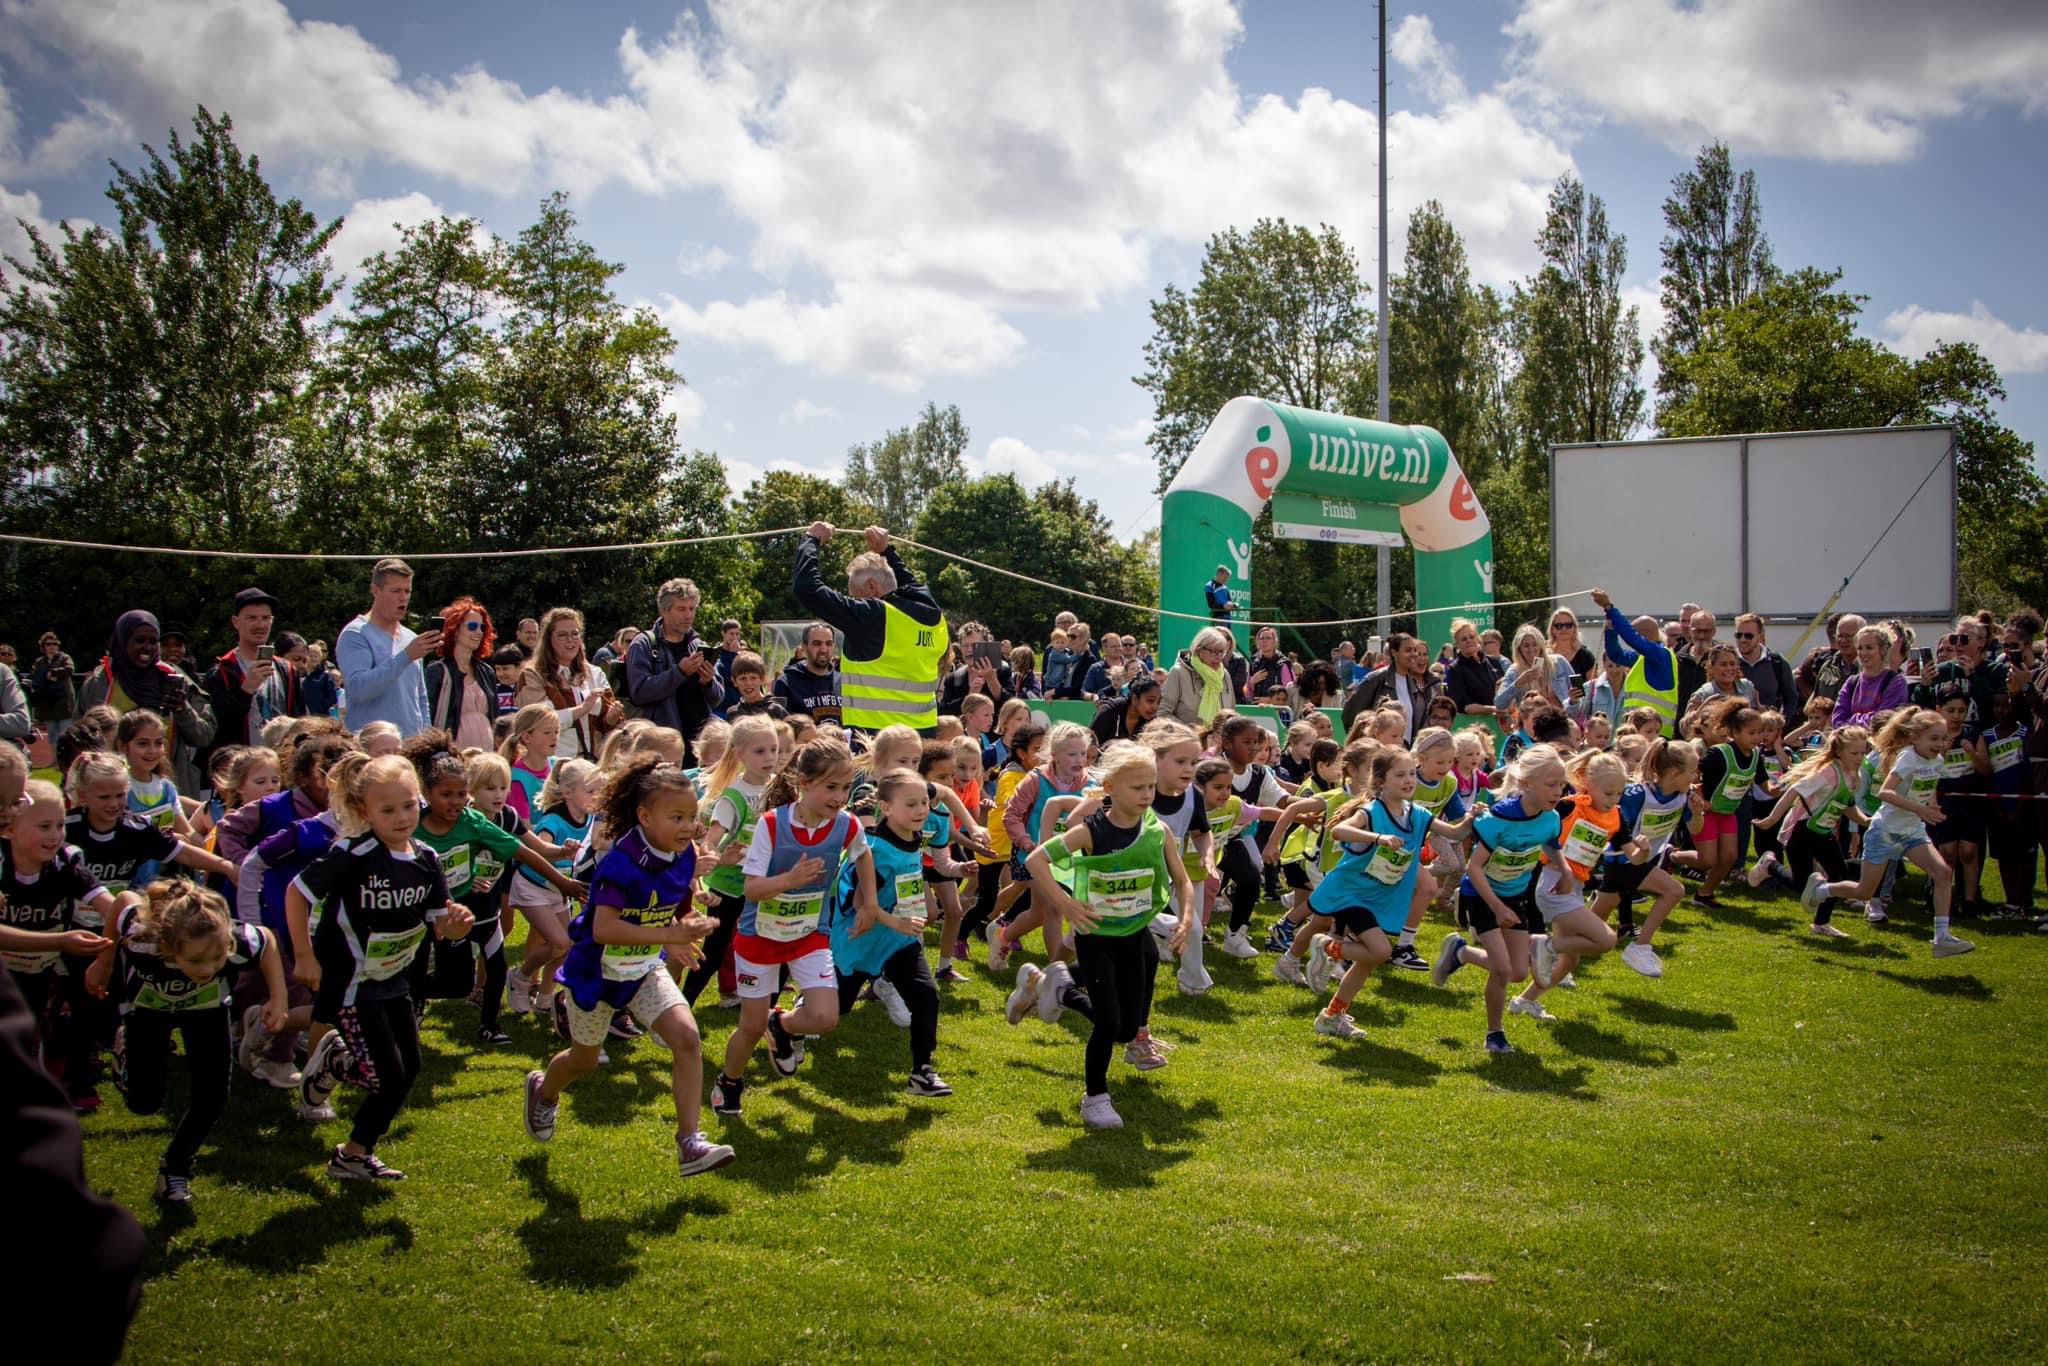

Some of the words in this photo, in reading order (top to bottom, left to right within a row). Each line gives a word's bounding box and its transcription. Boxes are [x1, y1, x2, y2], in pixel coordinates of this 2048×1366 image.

[1308, 426, 1431, 485] unive.nl
[1321, 500, 1357, 520] Finish
[368, 874, 390, 889] ikc
[1106, 879, 1137, 895] 344
[360, 884, 426, 910] haven
[778, 901, 807, 916] 546
